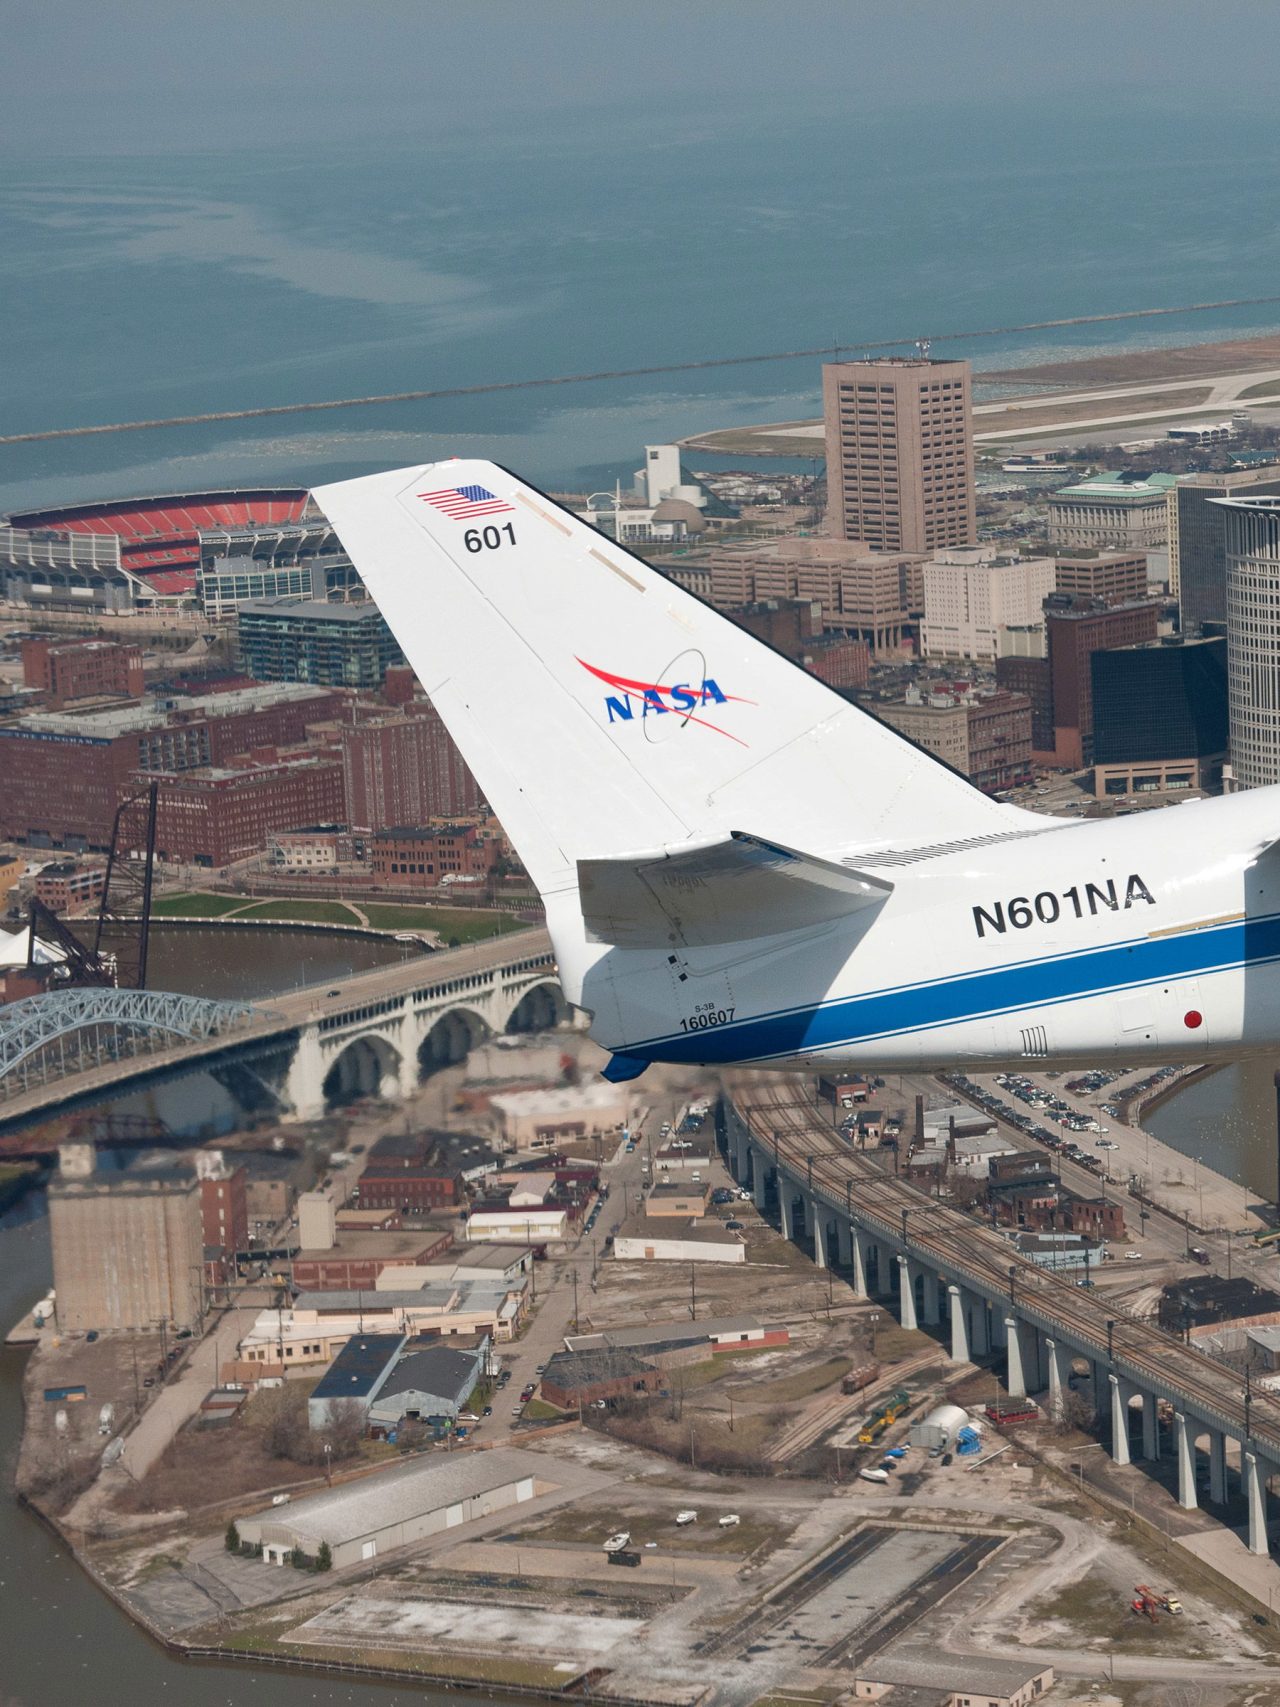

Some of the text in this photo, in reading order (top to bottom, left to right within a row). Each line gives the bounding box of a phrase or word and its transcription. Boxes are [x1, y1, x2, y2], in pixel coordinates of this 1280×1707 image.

[464, 522, 517, 553] 601
[604, 679, 728, 723] NASA
[972, 874, 1157, 938] N601NA
[680, 1007, 736, 1032] 160607
[694, 1002, 715, 1013] S-3B
